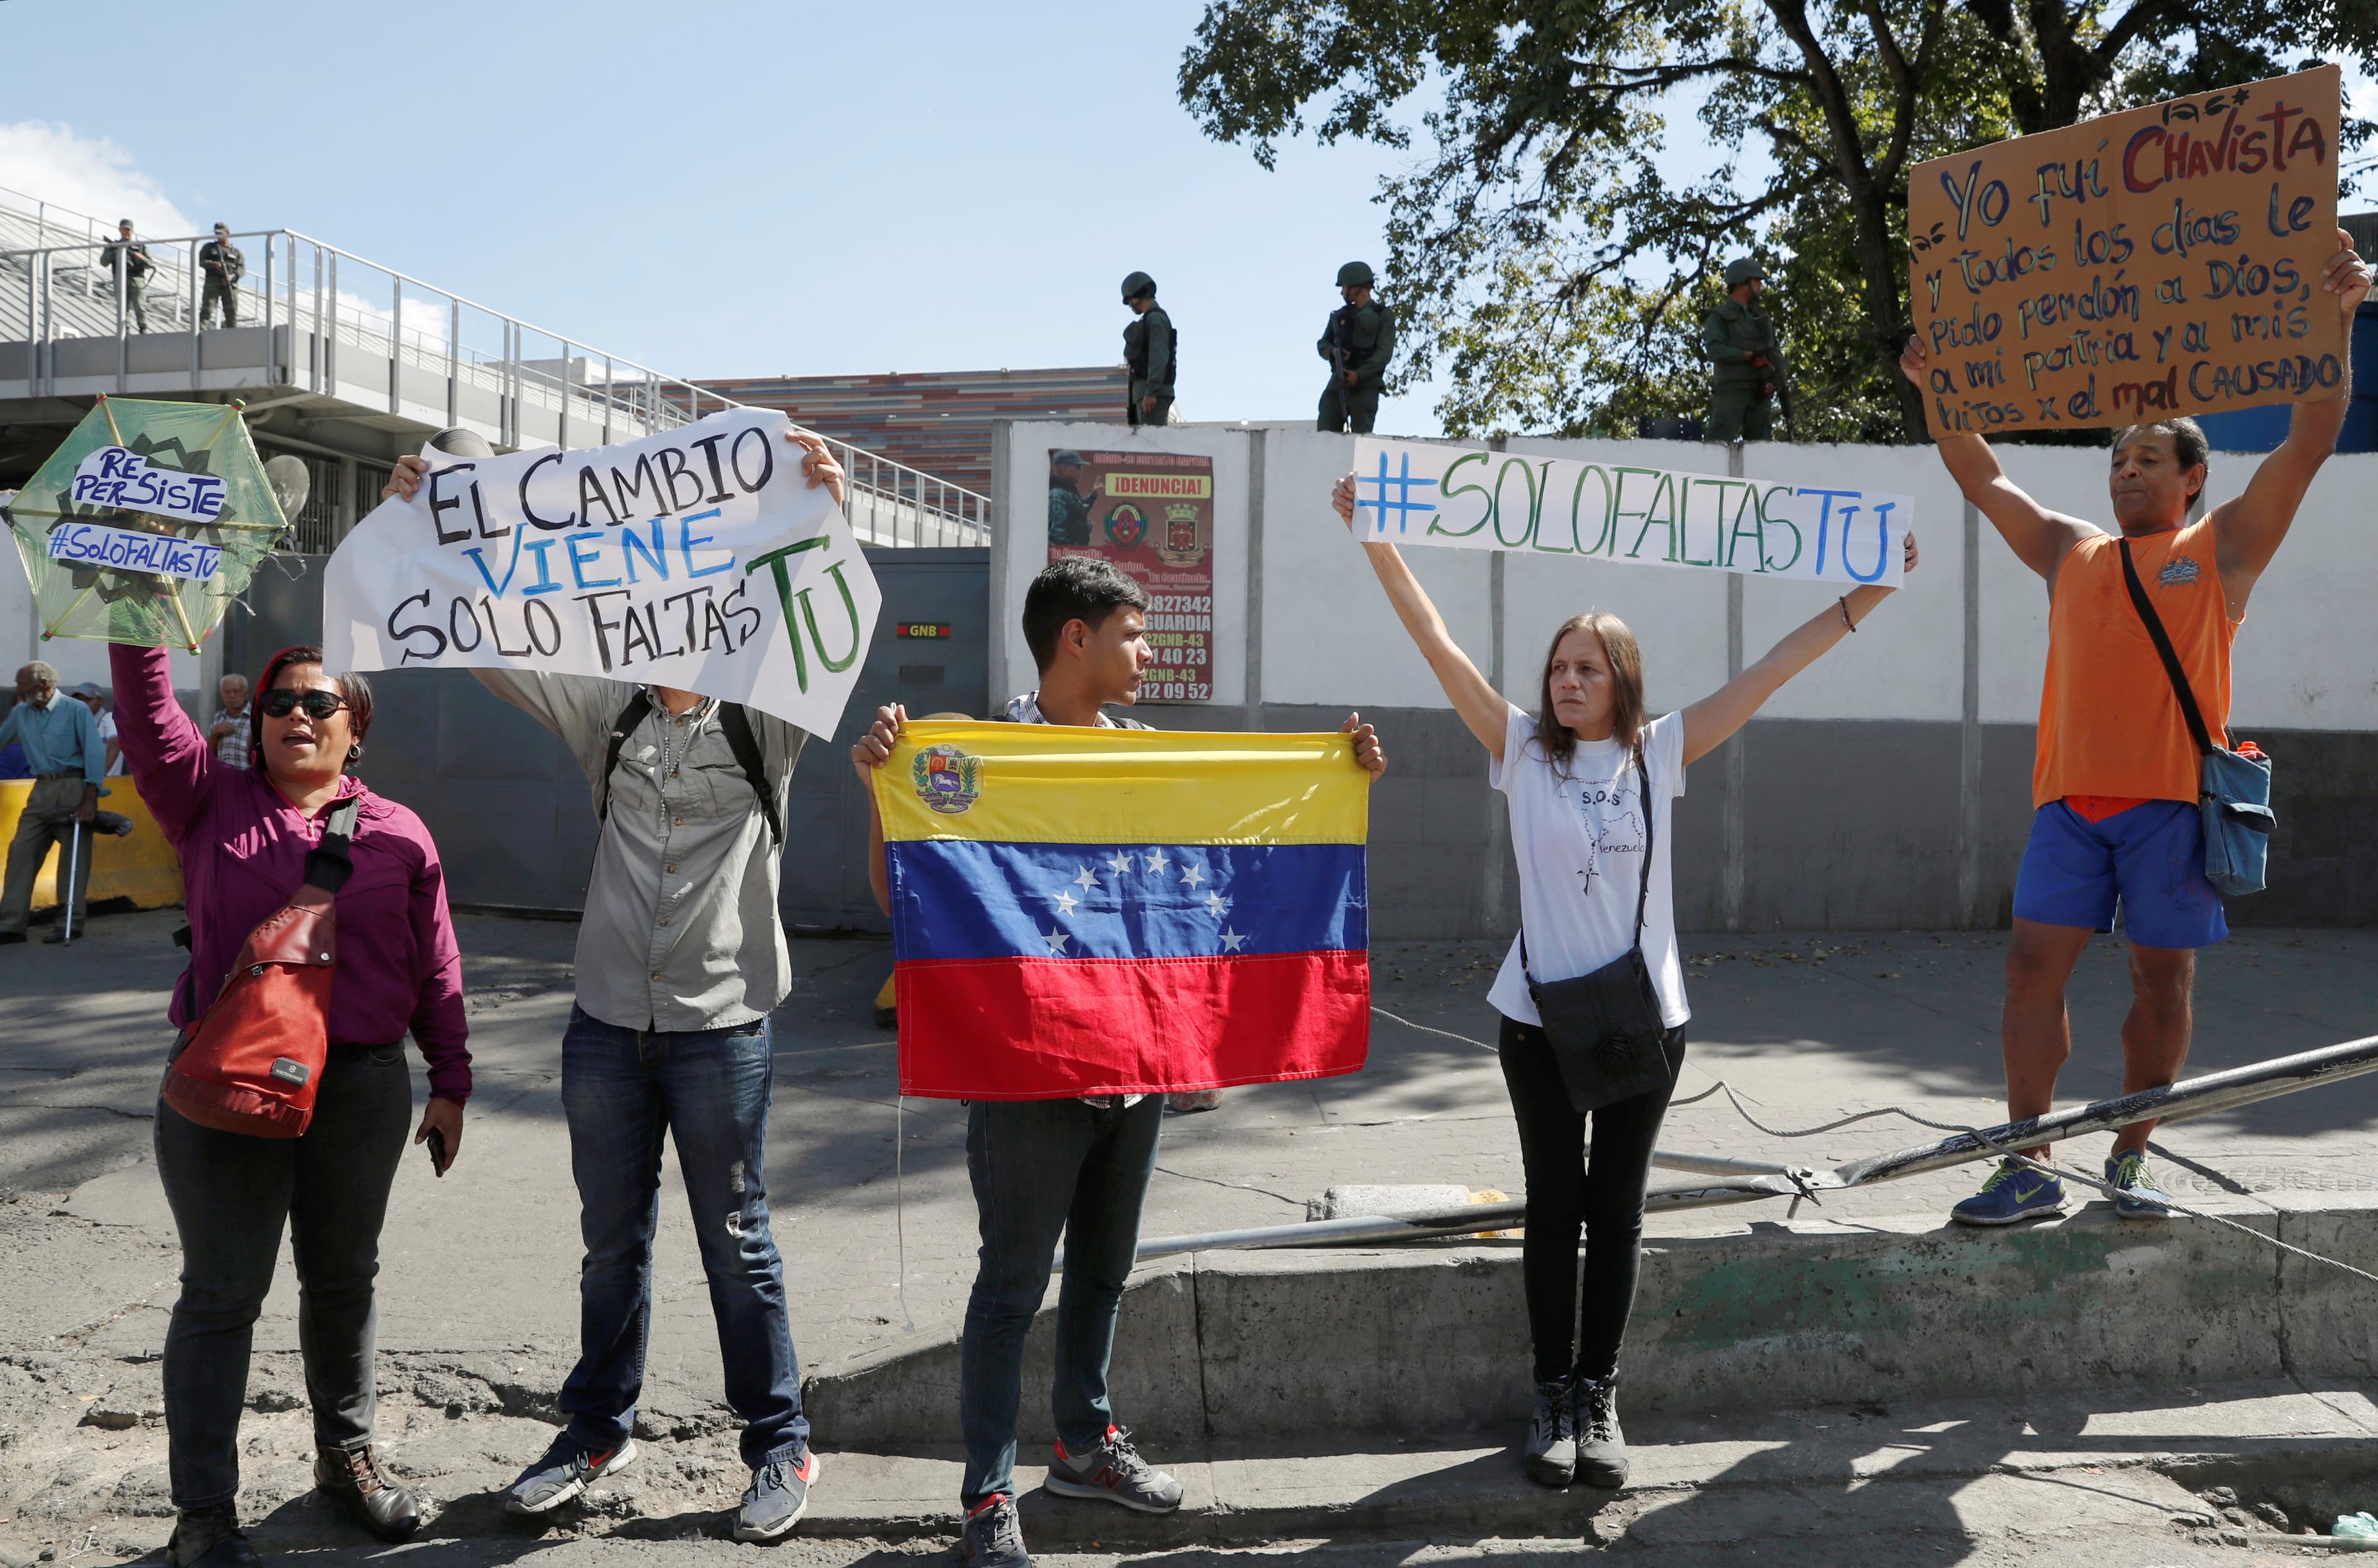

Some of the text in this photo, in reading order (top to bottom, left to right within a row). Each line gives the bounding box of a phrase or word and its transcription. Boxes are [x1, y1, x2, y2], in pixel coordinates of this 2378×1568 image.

[1940, 159, 2011, 242] Yo
[2074, 217, 2135, 268] los
[2268, 182, 2315, 238] le
[2017, 268, 2141, 341] perdón
[2154, 274, 2188, 305] a
[1930, 367, 1959, 396] a
[1964, 346, 2006, 390] mi
[2152, 325, 2174, 364] y
[2180, 320, 2211, 354] a
[2231, 298, 2313, 343] mis
[2067, 375, 2102, 420] el
[2112, 364, 2180, 418] mal
[2187, 352, 2343, 403] CAUSADO
[100, 448, 143, 479] RE
[429, 426, 774, 546] EL CAMBIO
[1115, 477, 1202, 495] ¡DENUNCIA!
[461, 507, 736, 601] VIENE
[387, 534, 861, 695] SOLO FALTAS TU
[910, 625, 937, 637] GNB
[1144, 614, 1211, 632] GUARDIA
[1149, 595, 1211, 612] 827342
[1162, 648, 1183, 664] 40
[1186, 648, 1207, 664] 23
[1164, 683, 1184, 699] 09
[1188, 683, 1208, 699] 52
